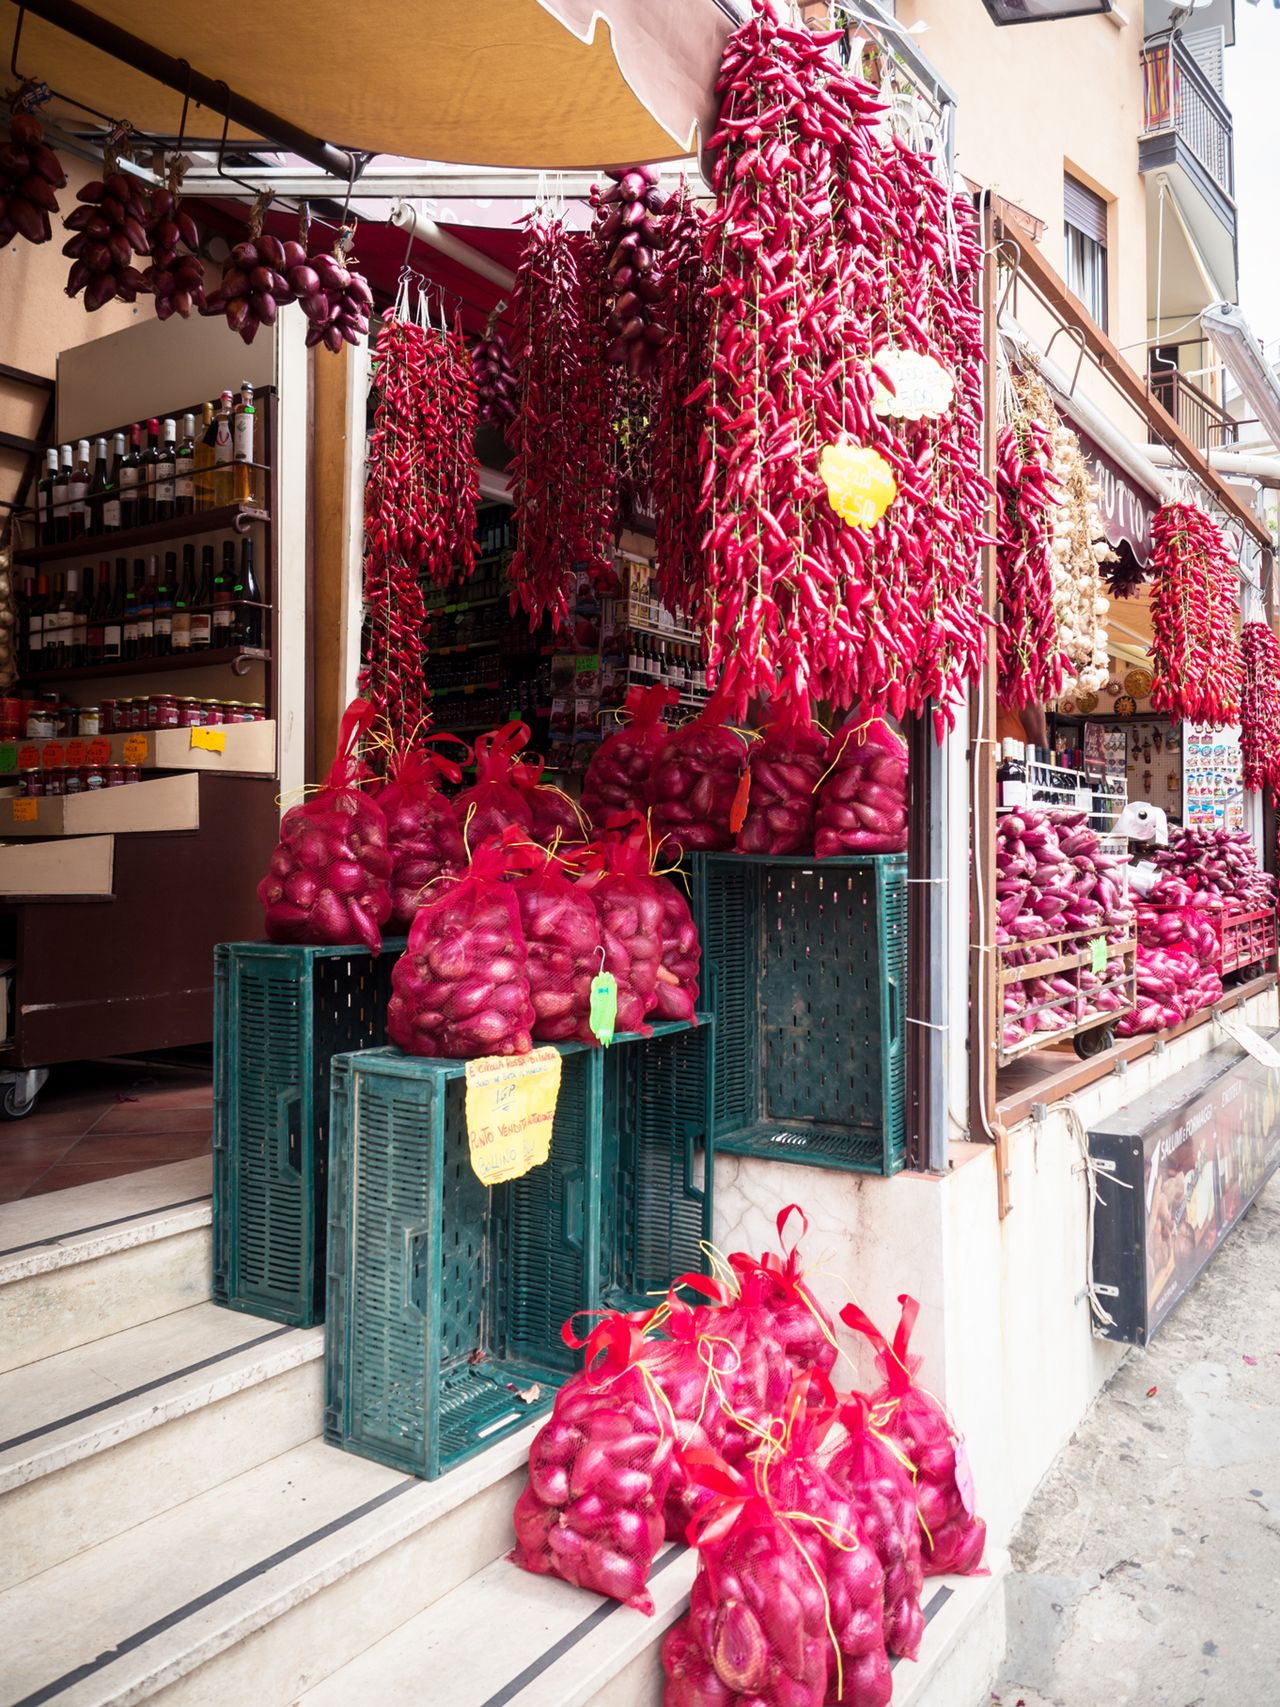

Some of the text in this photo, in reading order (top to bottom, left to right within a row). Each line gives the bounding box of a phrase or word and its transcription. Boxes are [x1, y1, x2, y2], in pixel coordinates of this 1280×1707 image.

[1095, 460, 1144, 543] TUTTO
[495, 1083, 517, 1105] IGP
[470, 1126, 495, 1151] PUNTO
[1161, 1126, 1184, 1161] SALUMI
[1185, 1103, 1213, 1140] FORMAGGI
